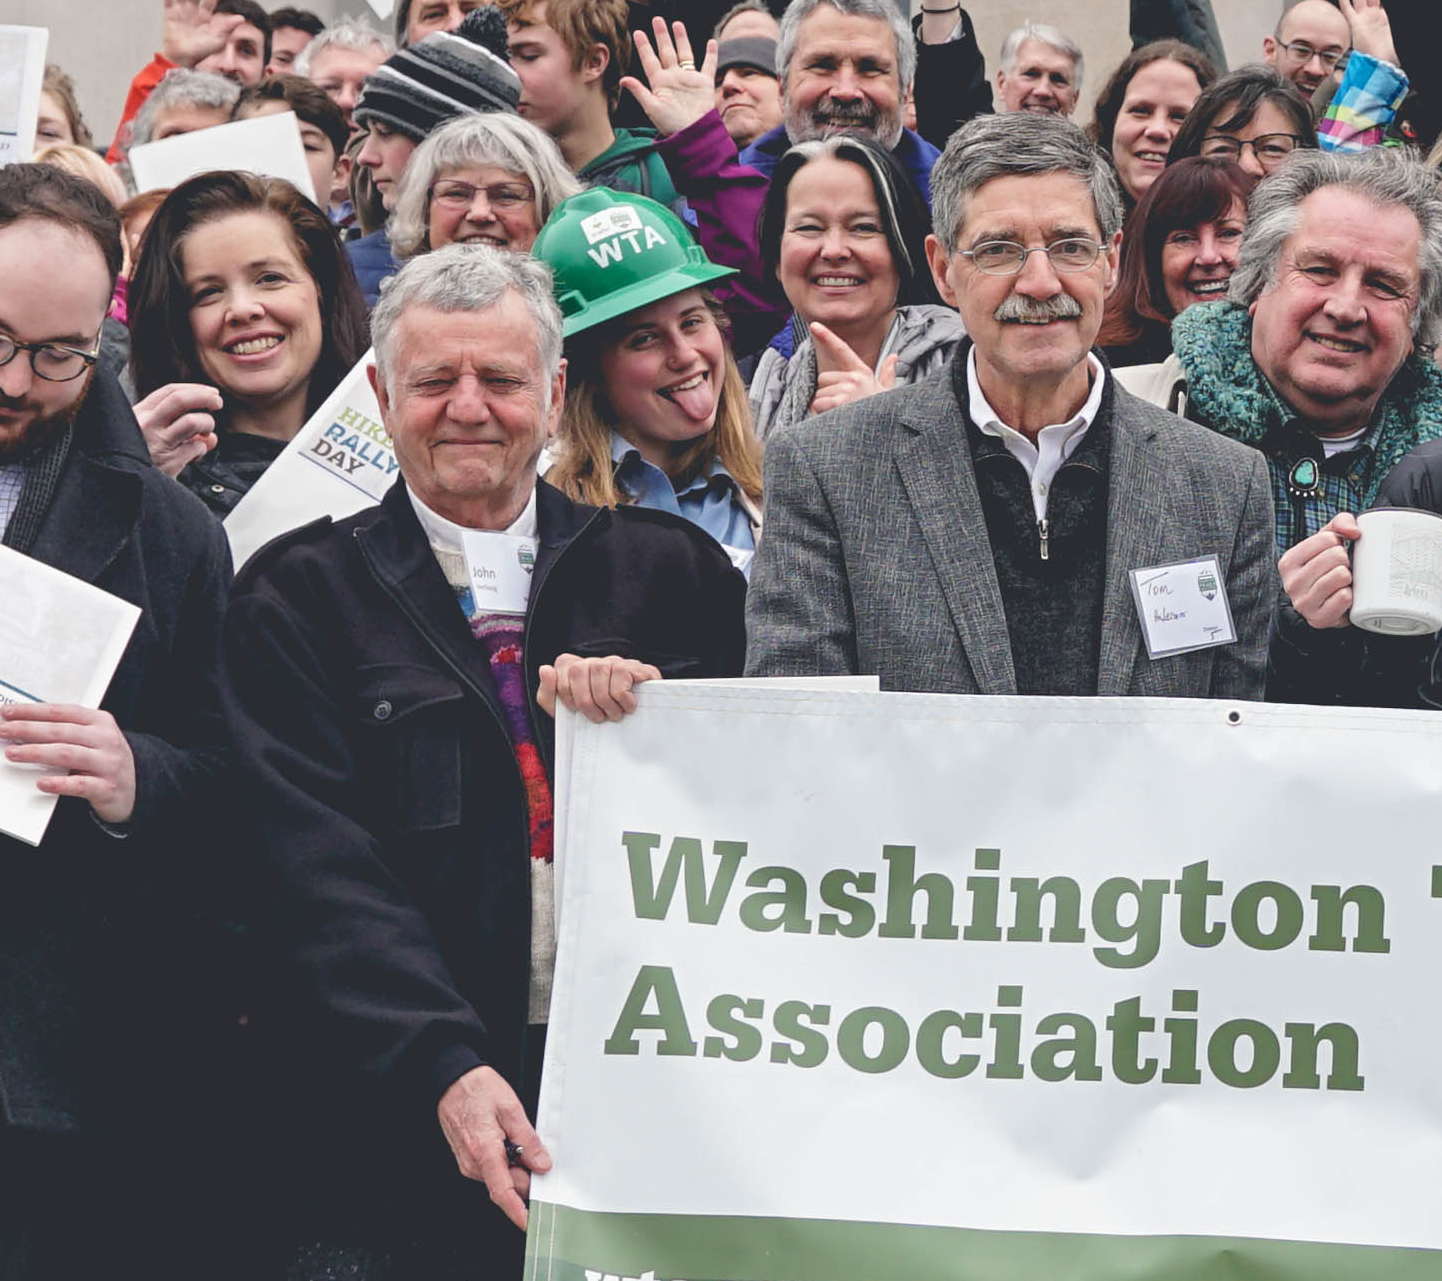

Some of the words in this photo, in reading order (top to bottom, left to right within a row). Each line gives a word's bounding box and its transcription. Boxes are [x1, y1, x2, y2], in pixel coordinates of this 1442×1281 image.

[587, 226, 667, 269] WTA
[324, 422, 398, 474] RALLY
[337, 405, 394, 450] HIKE
[311, 438, 366, 474] DAY
[473, 566, 496, 579] John
[622, 831, 1390, 969] Washington
[604, 965, 1364, 1091] Association
